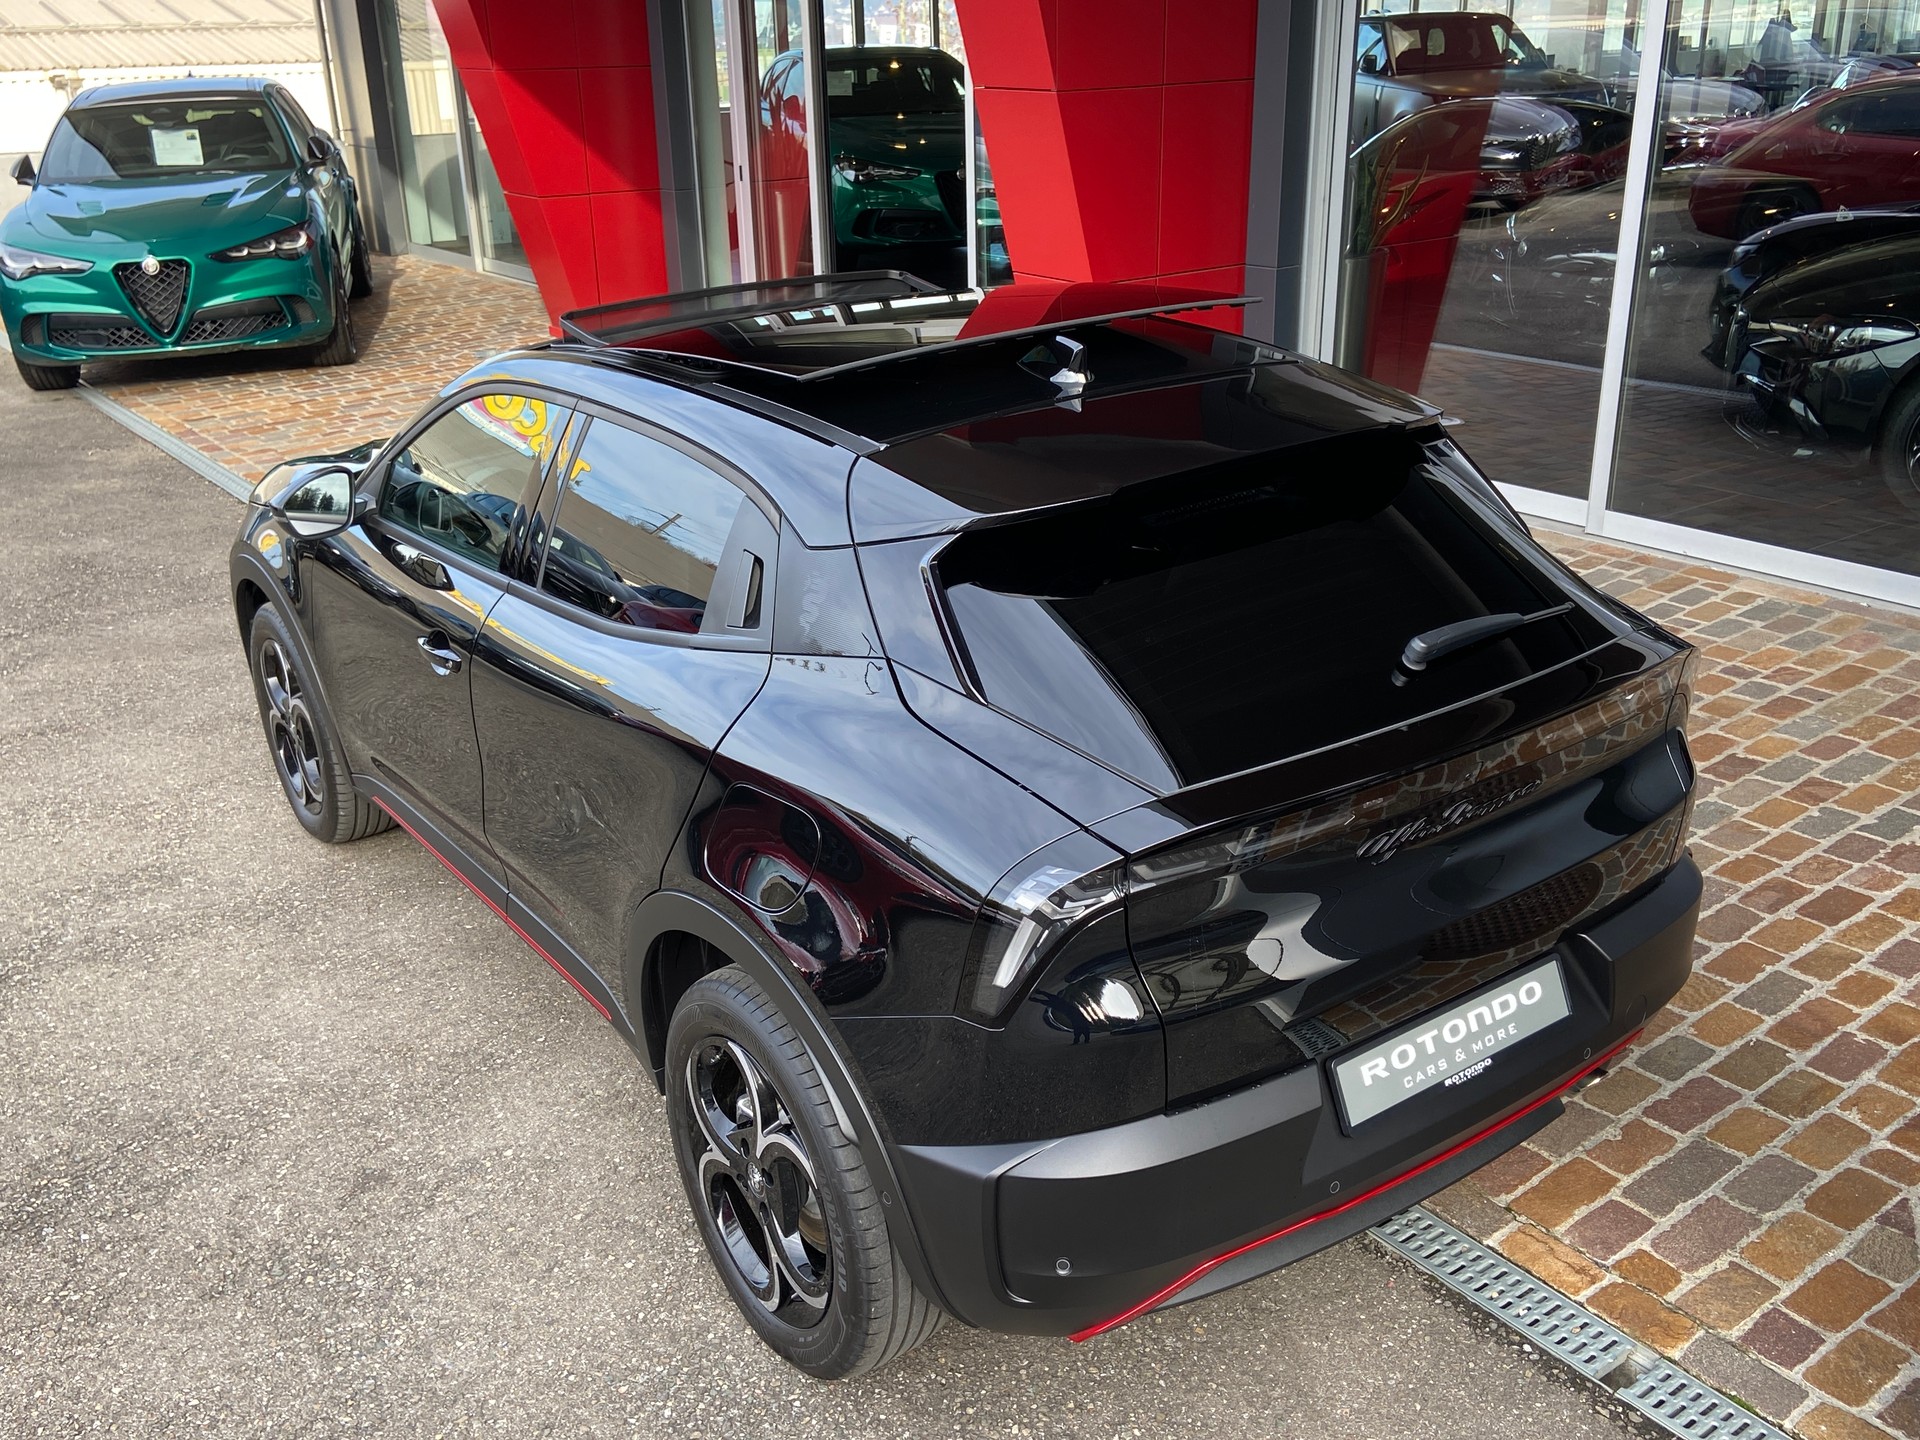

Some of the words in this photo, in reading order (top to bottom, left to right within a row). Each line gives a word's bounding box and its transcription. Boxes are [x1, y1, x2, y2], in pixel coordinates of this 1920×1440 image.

[1360, 981, 1542, 1086] ROTONDO
[1403, 1058, 1448, 1088] CARS
[1455, 1048, 1467, 1062] &
[1473, 1023, 1518, 1053] MORE
[1444, 1058, 1492, 1087] ROTONDO
